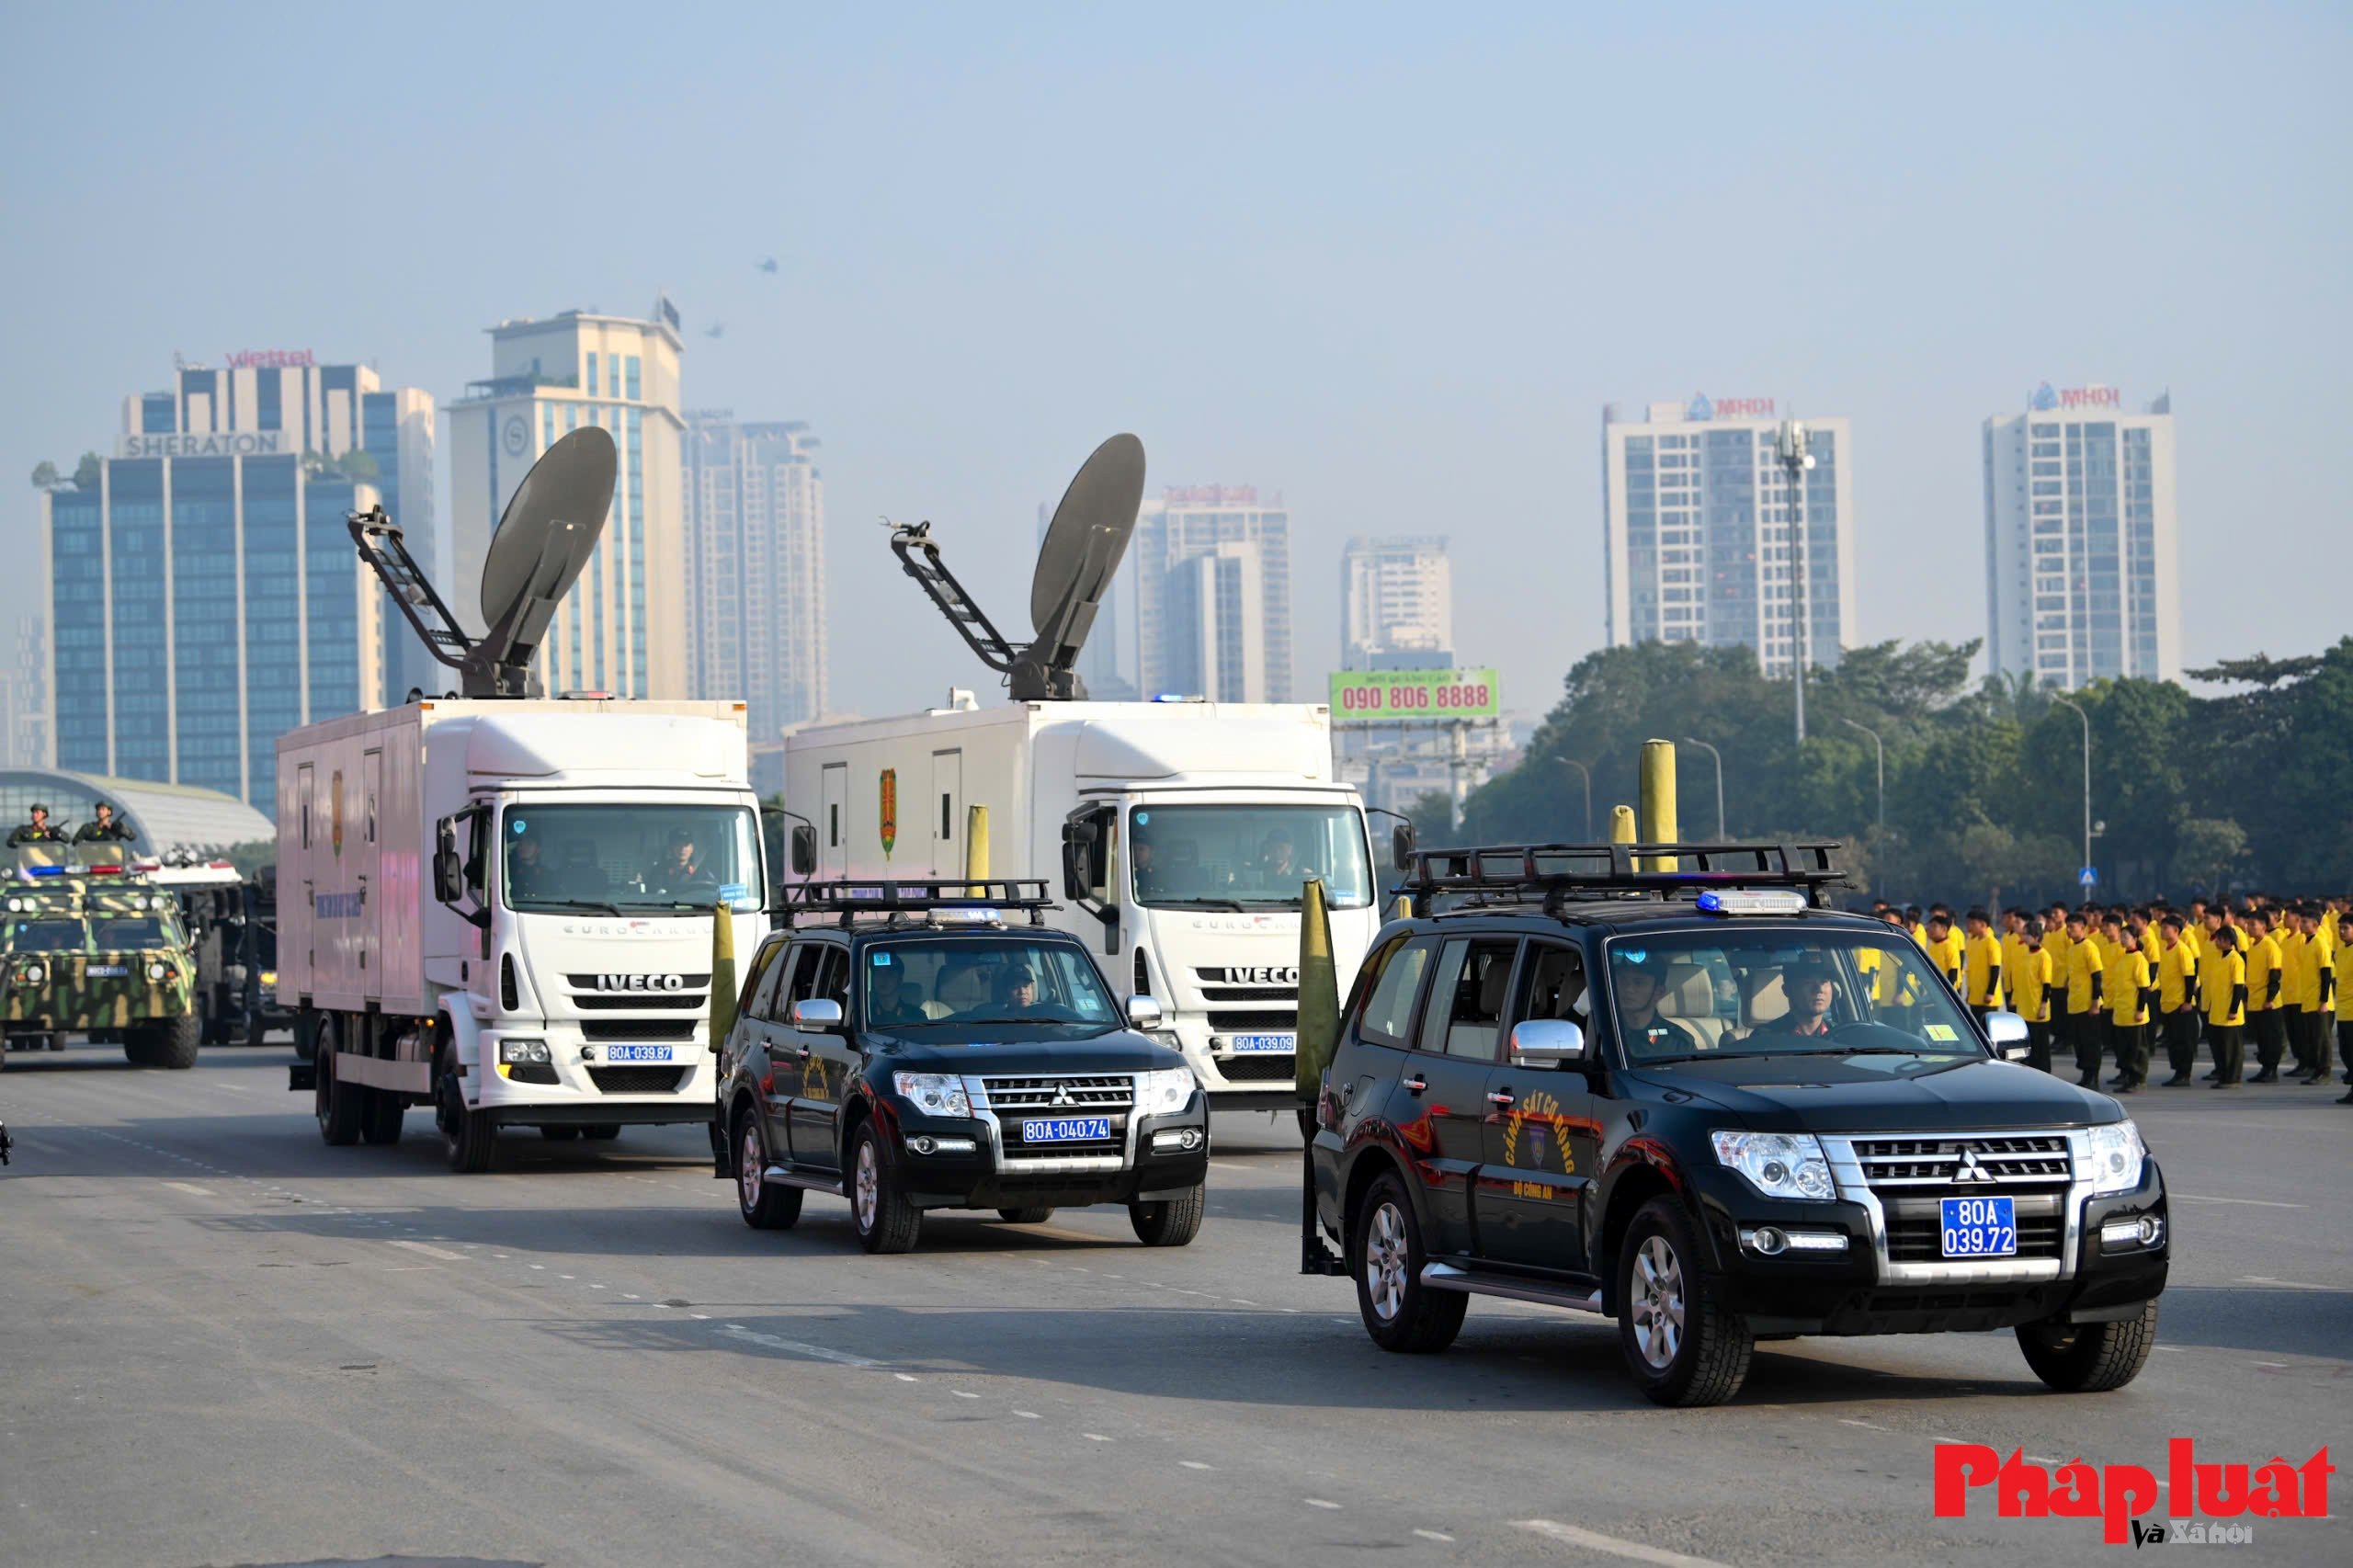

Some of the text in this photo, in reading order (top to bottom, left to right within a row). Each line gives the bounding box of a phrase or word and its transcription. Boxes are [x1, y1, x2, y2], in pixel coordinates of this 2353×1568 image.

[125, 435, 278, 456] SHERATON
[1342, 685, 1489, 710] 090 806 8888
[597, 974, 684, 992] IVECO
[1224, 968, 1301, 983] IVECO
[608, 1045, 672, 1060] 80A-039.87
[1235, 1036, 1293, 1051] 80A-039.09
[1523, 1089, 1544, 1118] SÁT
[1026, 1120, 1108, 1140] 80A-040.74
[1542, 1185, 1552, 1200] AN
[1959, 1200, 1998, 1225] 80A
[1945, 1226, 2014, 1254] 039.72
